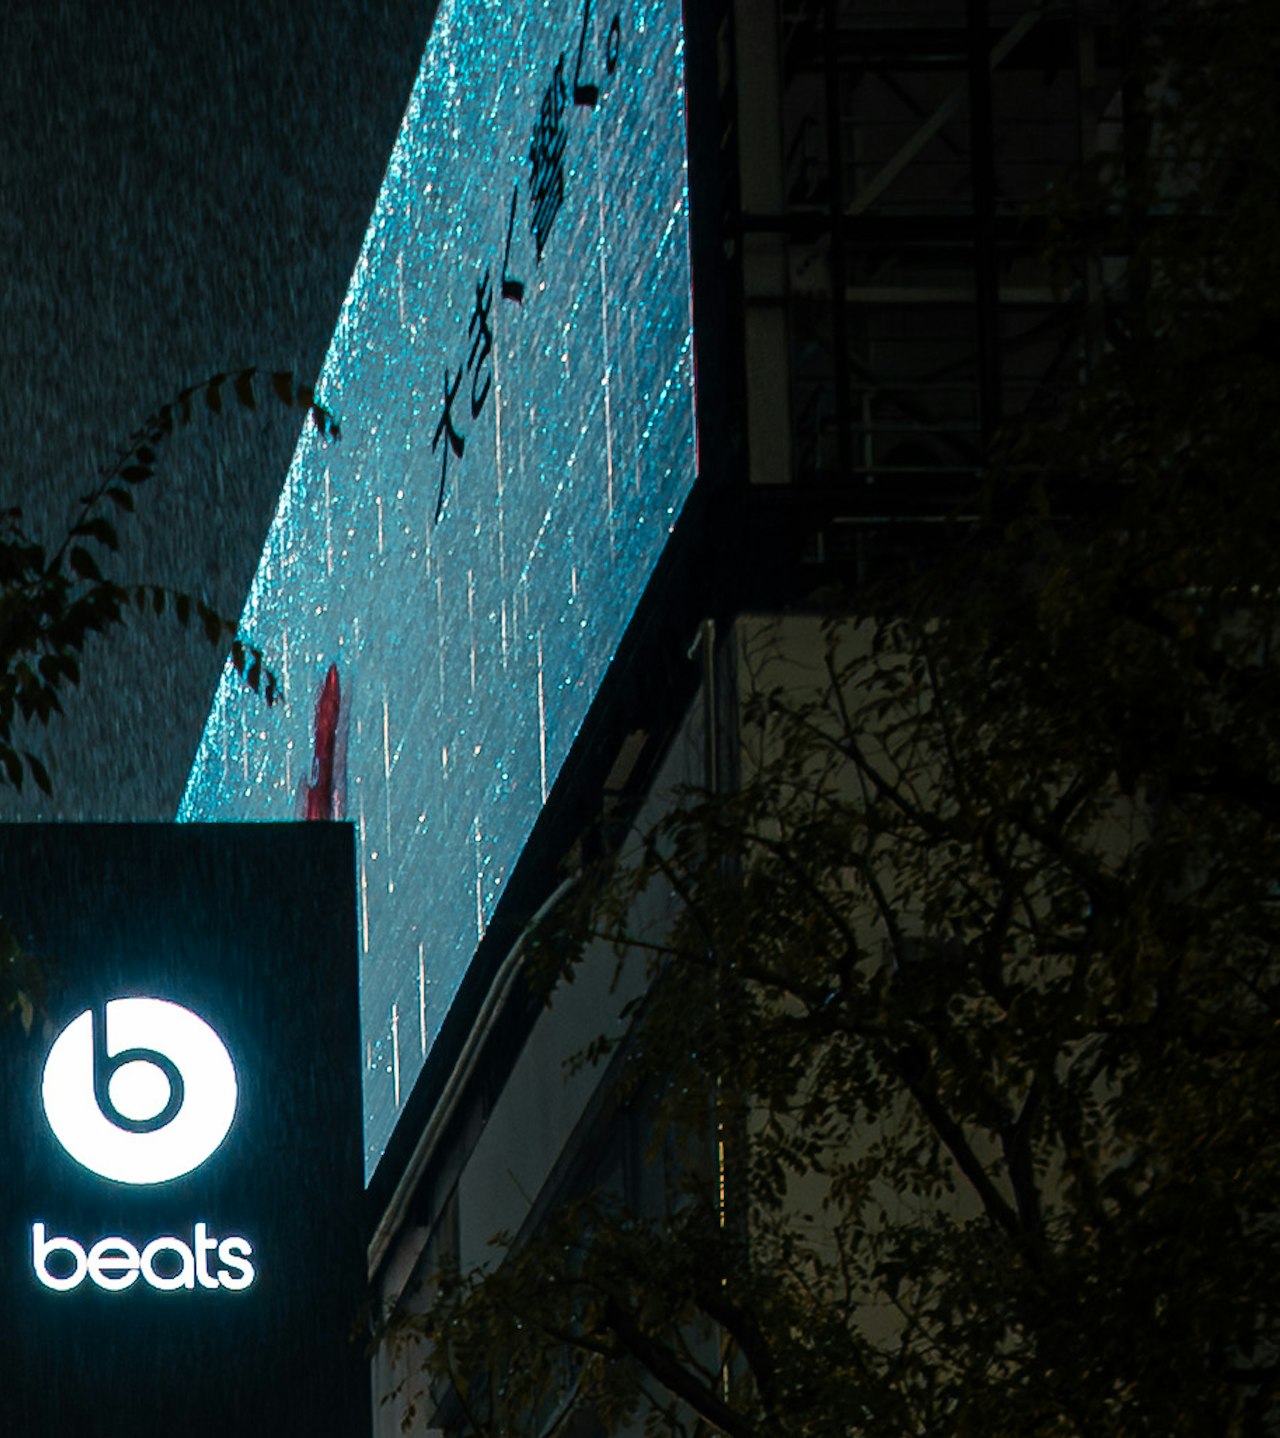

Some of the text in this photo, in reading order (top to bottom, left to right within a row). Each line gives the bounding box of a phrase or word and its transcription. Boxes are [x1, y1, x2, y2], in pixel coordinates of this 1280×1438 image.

[431, 0, 620, 526] 大きく響く。
[32, 1222, 256, 1291] beats
